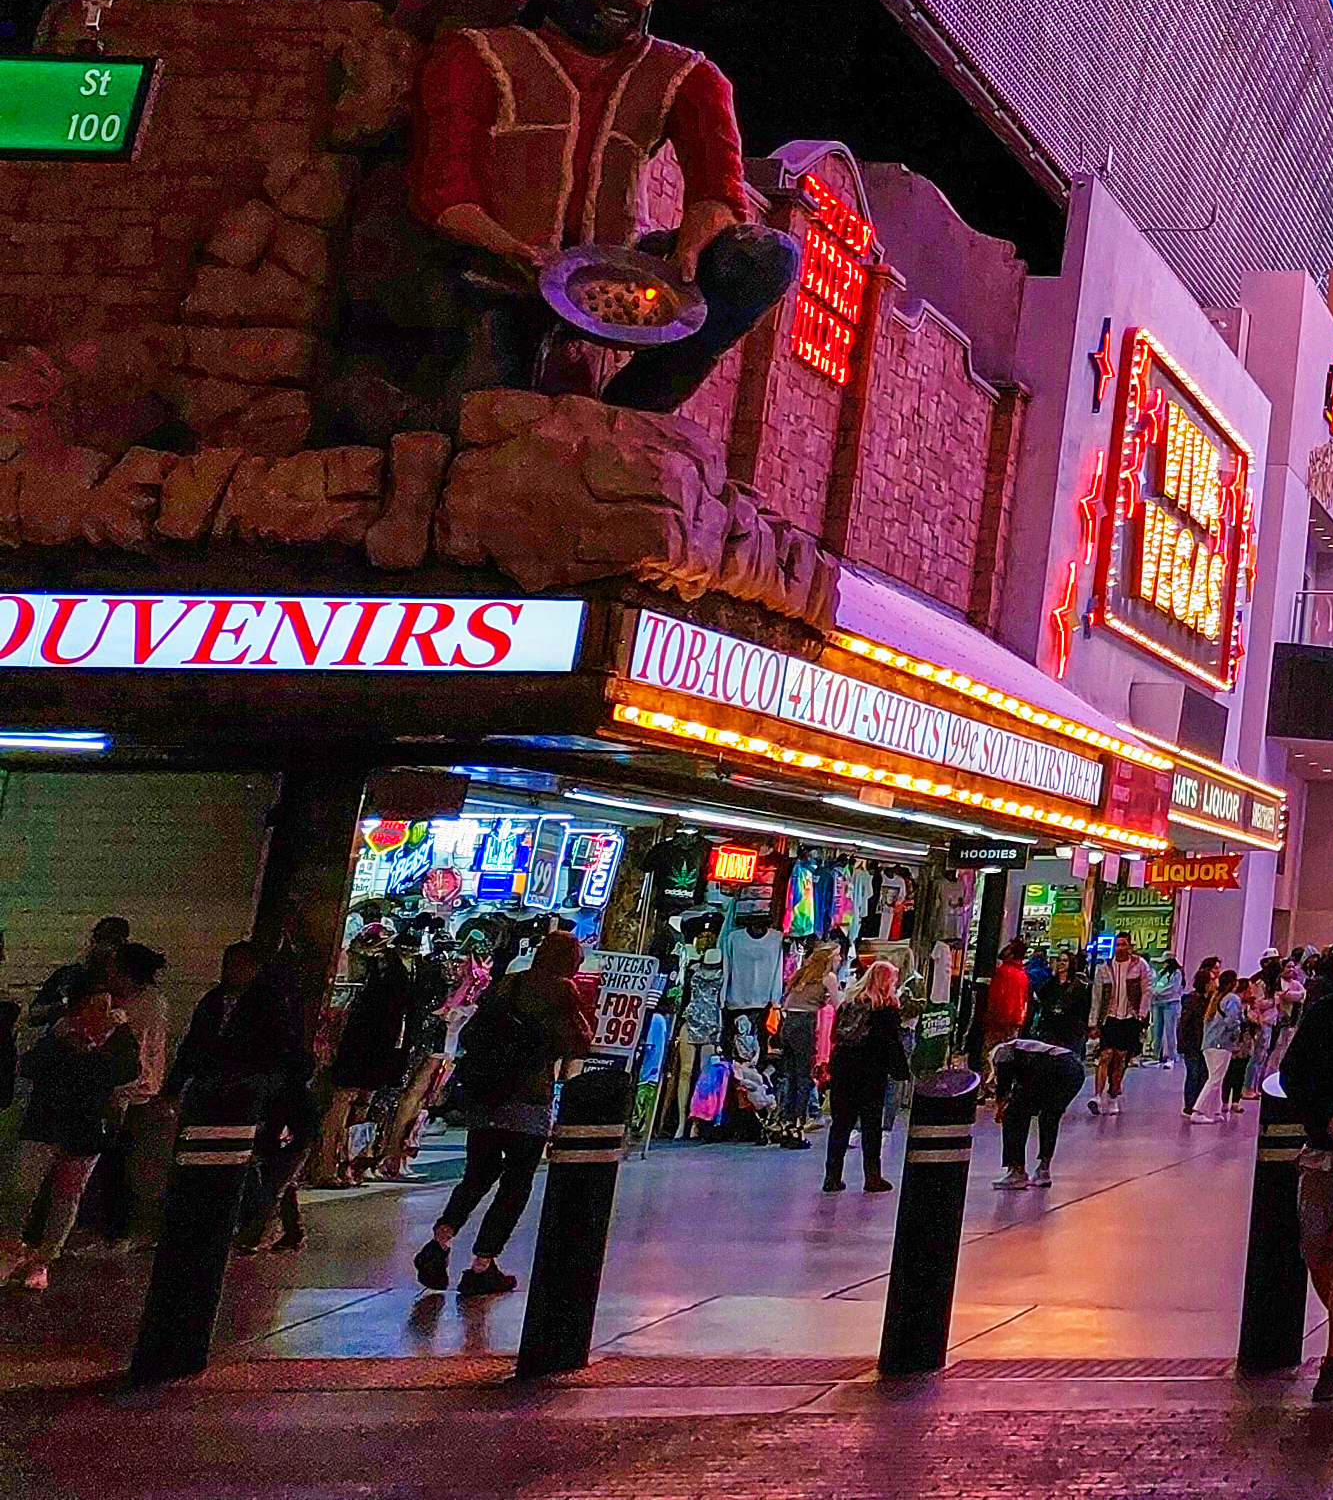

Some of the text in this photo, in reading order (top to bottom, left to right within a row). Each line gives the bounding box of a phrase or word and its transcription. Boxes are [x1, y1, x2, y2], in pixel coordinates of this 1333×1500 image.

[80, 68, 112, 96] St
[67, 113, 121, 142] 100
[636, 615, 1100, 806] TOBACCO 4X10 T-SHIRTS 99¢ SOUVENIRS BEER
[1171, 772, 1198, 810] HATS
[1202, 784, 1241, 823] LIQUOR
[959, 848, 1018, 862] HOODIES
[1150, 861, 1230, 883] LIQUOR
[1115, 915, 1171, 927] DISPOSABLE
[1115, 928, 1169, 950] APE
[617, 957, 654, 976] VEGAS
[600, 971, 648, 991] SHIRTS
[601, 992, 643, 1019] FOR
